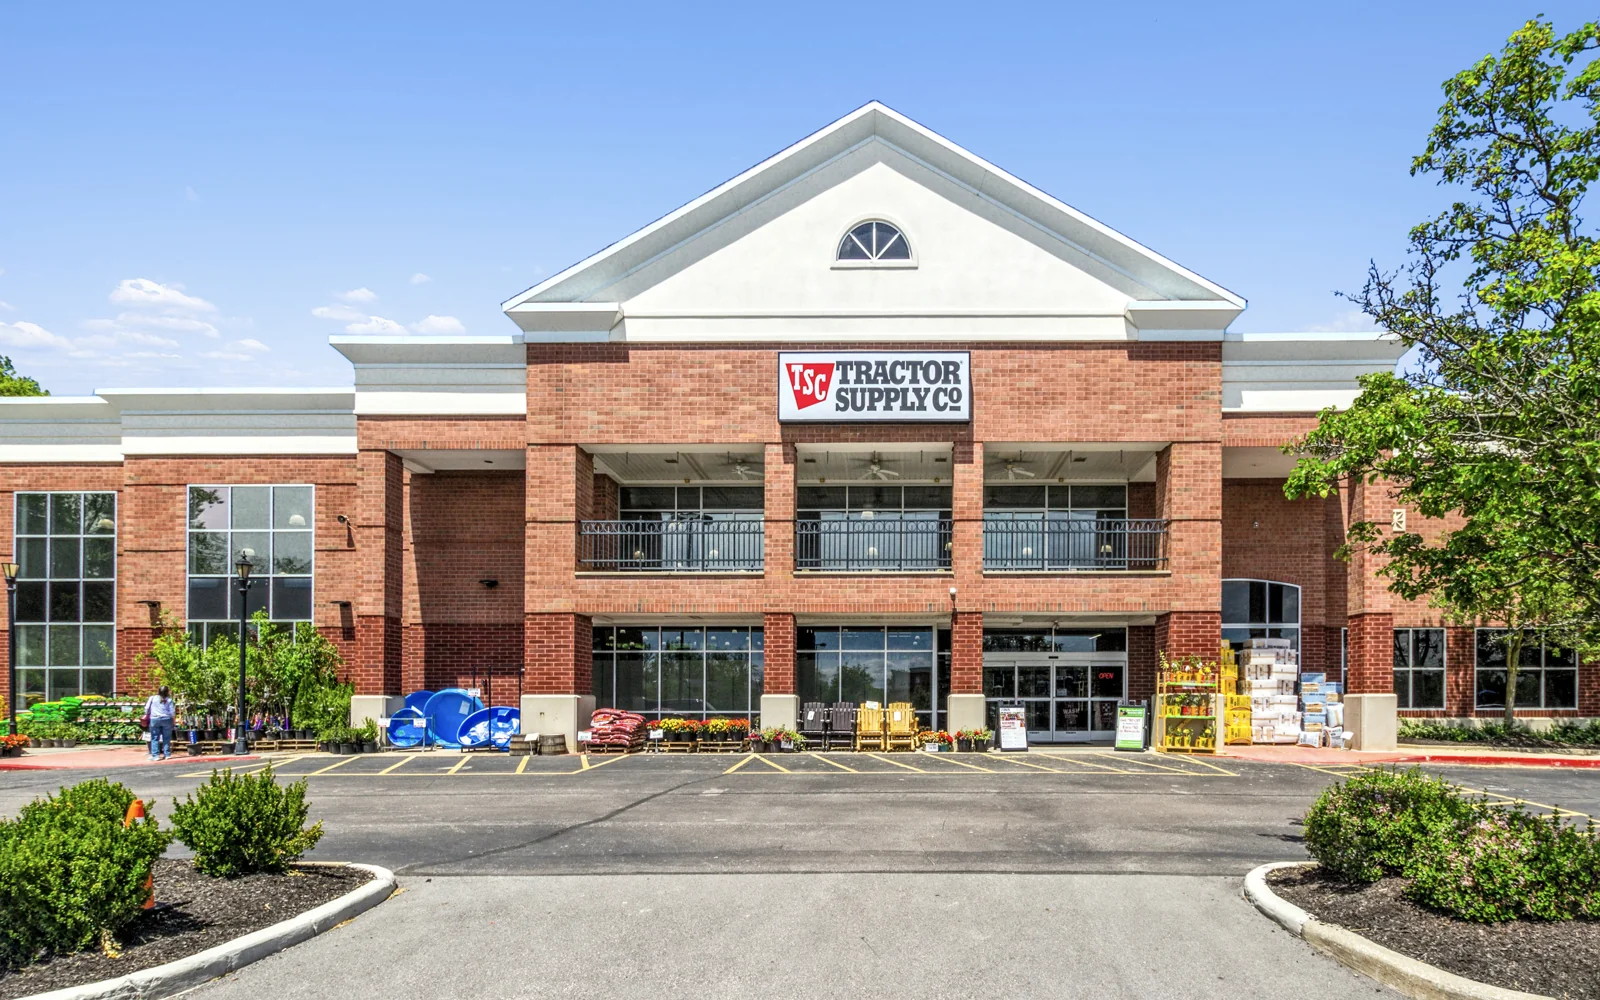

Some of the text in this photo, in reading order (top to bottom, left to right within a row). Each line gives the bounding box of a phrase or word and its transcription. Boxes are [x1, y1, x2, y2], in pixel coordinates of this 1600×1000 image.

[791, 364, 827, 401] TSC
[835, 360, 962, 385] TRACTOR
[835, 387, 930, 412] SUPPLY
